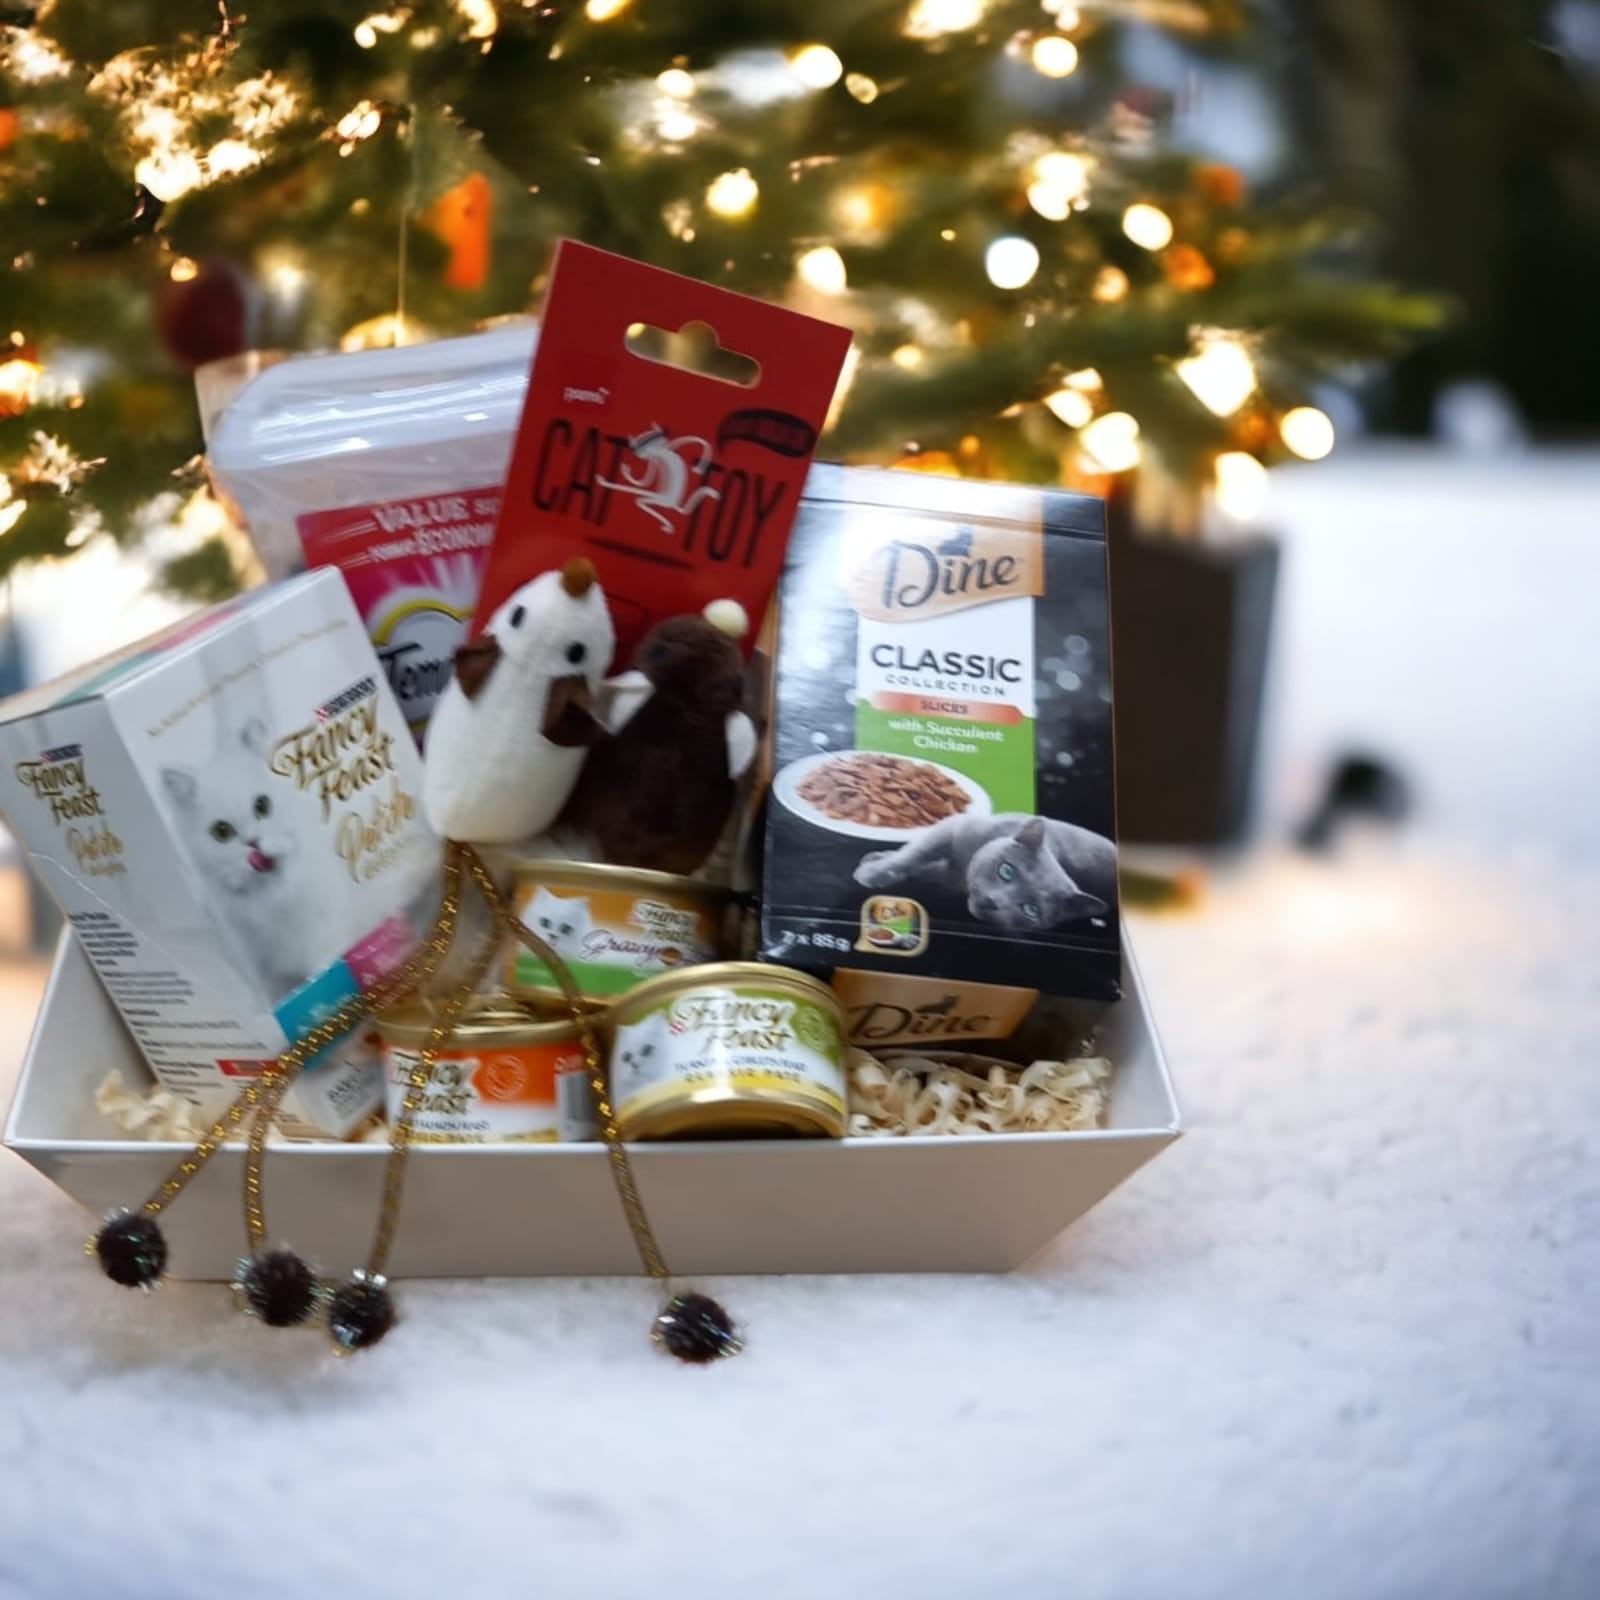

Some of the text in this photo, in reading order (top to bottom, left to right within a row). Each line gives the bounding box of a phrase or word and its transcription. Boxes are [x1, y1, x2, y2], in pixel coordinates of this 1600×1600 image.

[532, 416, 633, 527] CAT
[682, 455, 789, 569] TOY
[371, 496, 471, 533] VALUE
[881, 538, 1019, 608] Dine
[870, 643, 1022, 683] CLASSIC
[884, 673, 1006, 696] COLLECTION
[919, 699, 970, 715] SLICES
[266, 692, 379, 790] Fancy
[887, 717, 1005, 742] with Succulent
[912, 735, 979, 754] Chicken
[305, 732, 395, 825] Feast
[848, 1002, 991, 1041] Dine
